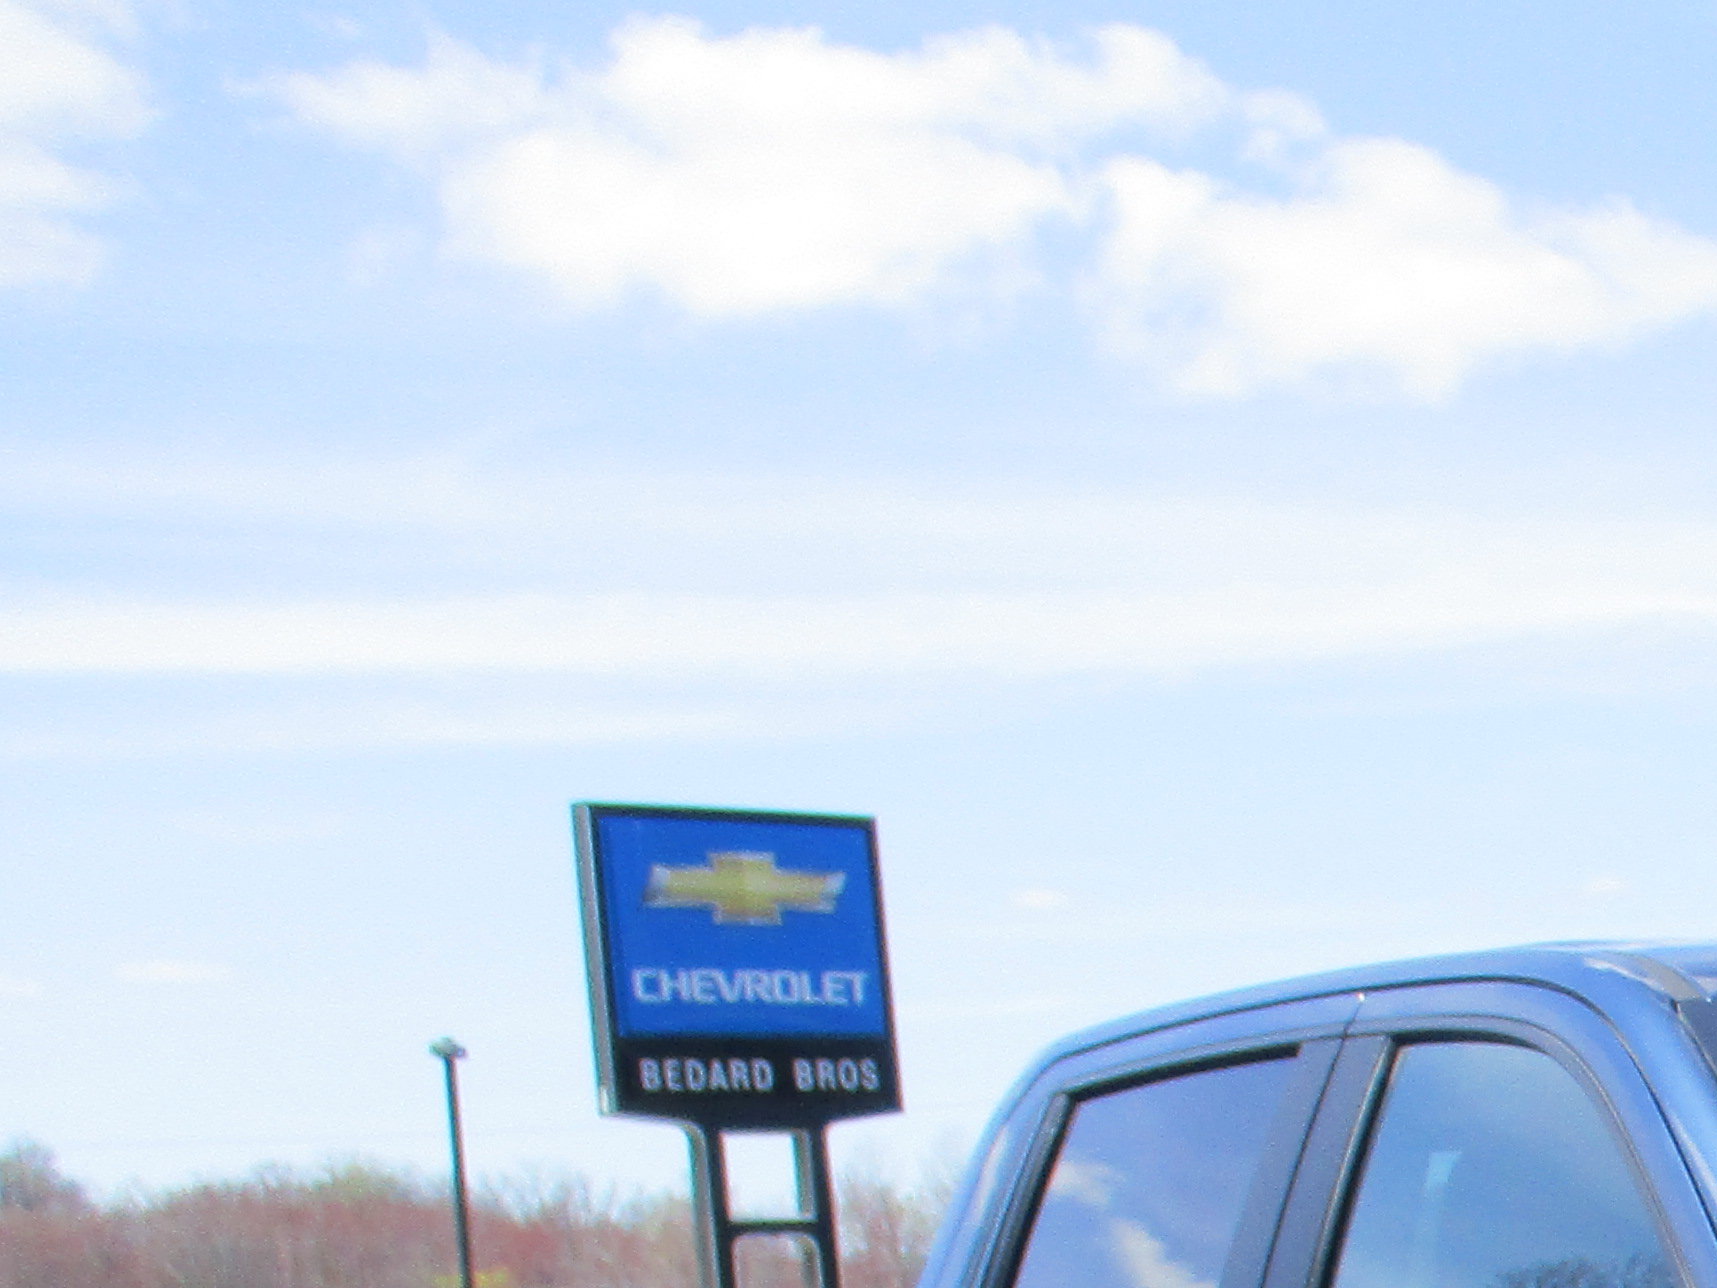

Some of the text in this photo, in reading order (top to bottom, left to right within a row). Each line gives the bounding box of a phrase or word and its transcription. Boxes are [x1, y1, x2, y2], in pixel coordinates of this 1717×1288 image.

[631, 967, 868, 1005] CHEVROLET
[638, 1056, 881, 1092] BEDARD BROS
